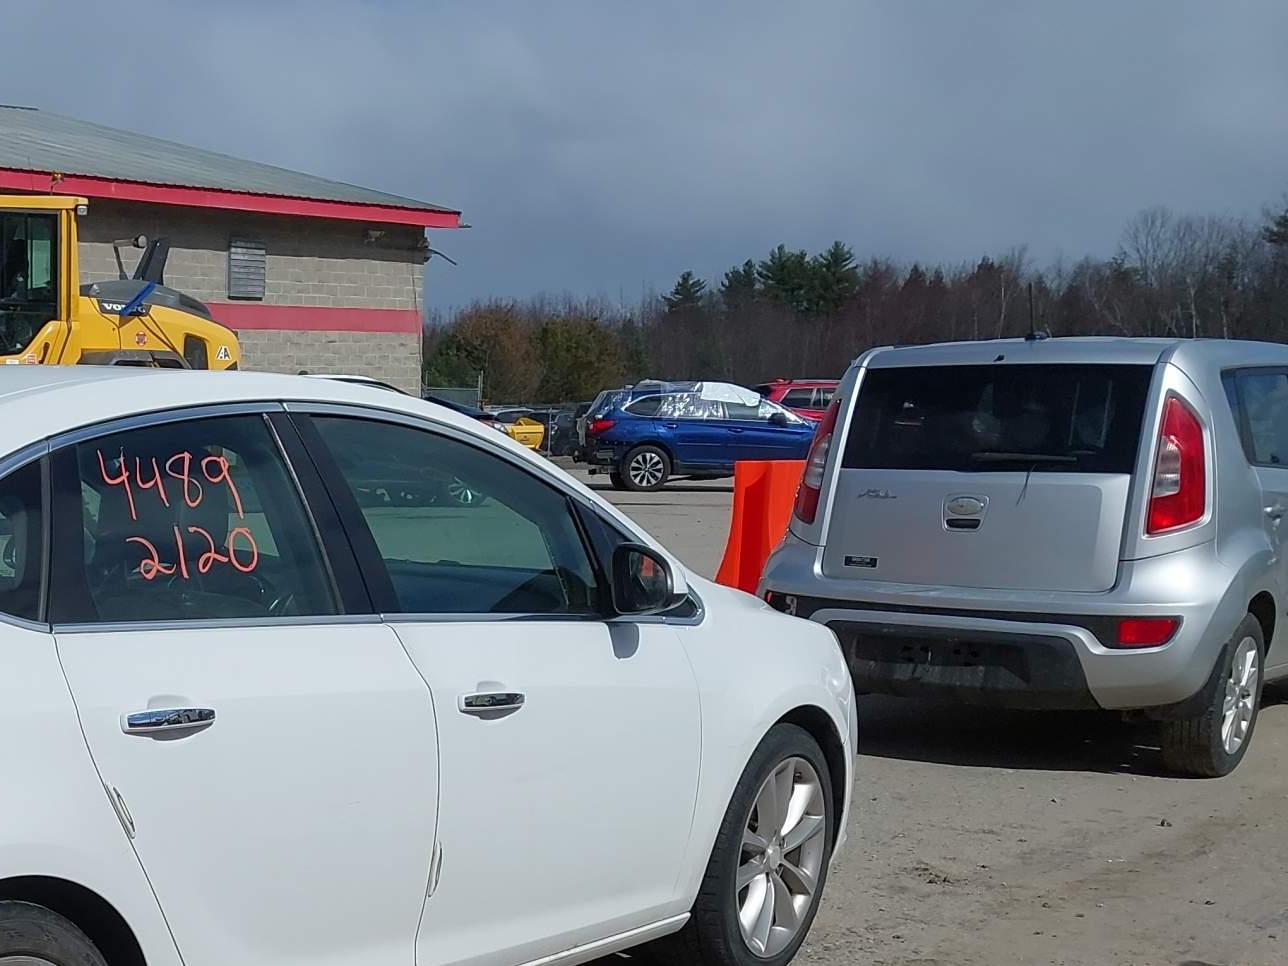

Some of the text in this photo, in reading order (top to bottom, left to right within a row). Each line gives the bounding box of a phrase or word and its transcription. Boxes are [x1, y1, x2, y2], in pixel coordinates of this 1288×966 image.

[101, 302, 146, 313] VOO
[96, 447, 244, 520] 4489
[125, 524, 258, 579] 2120
